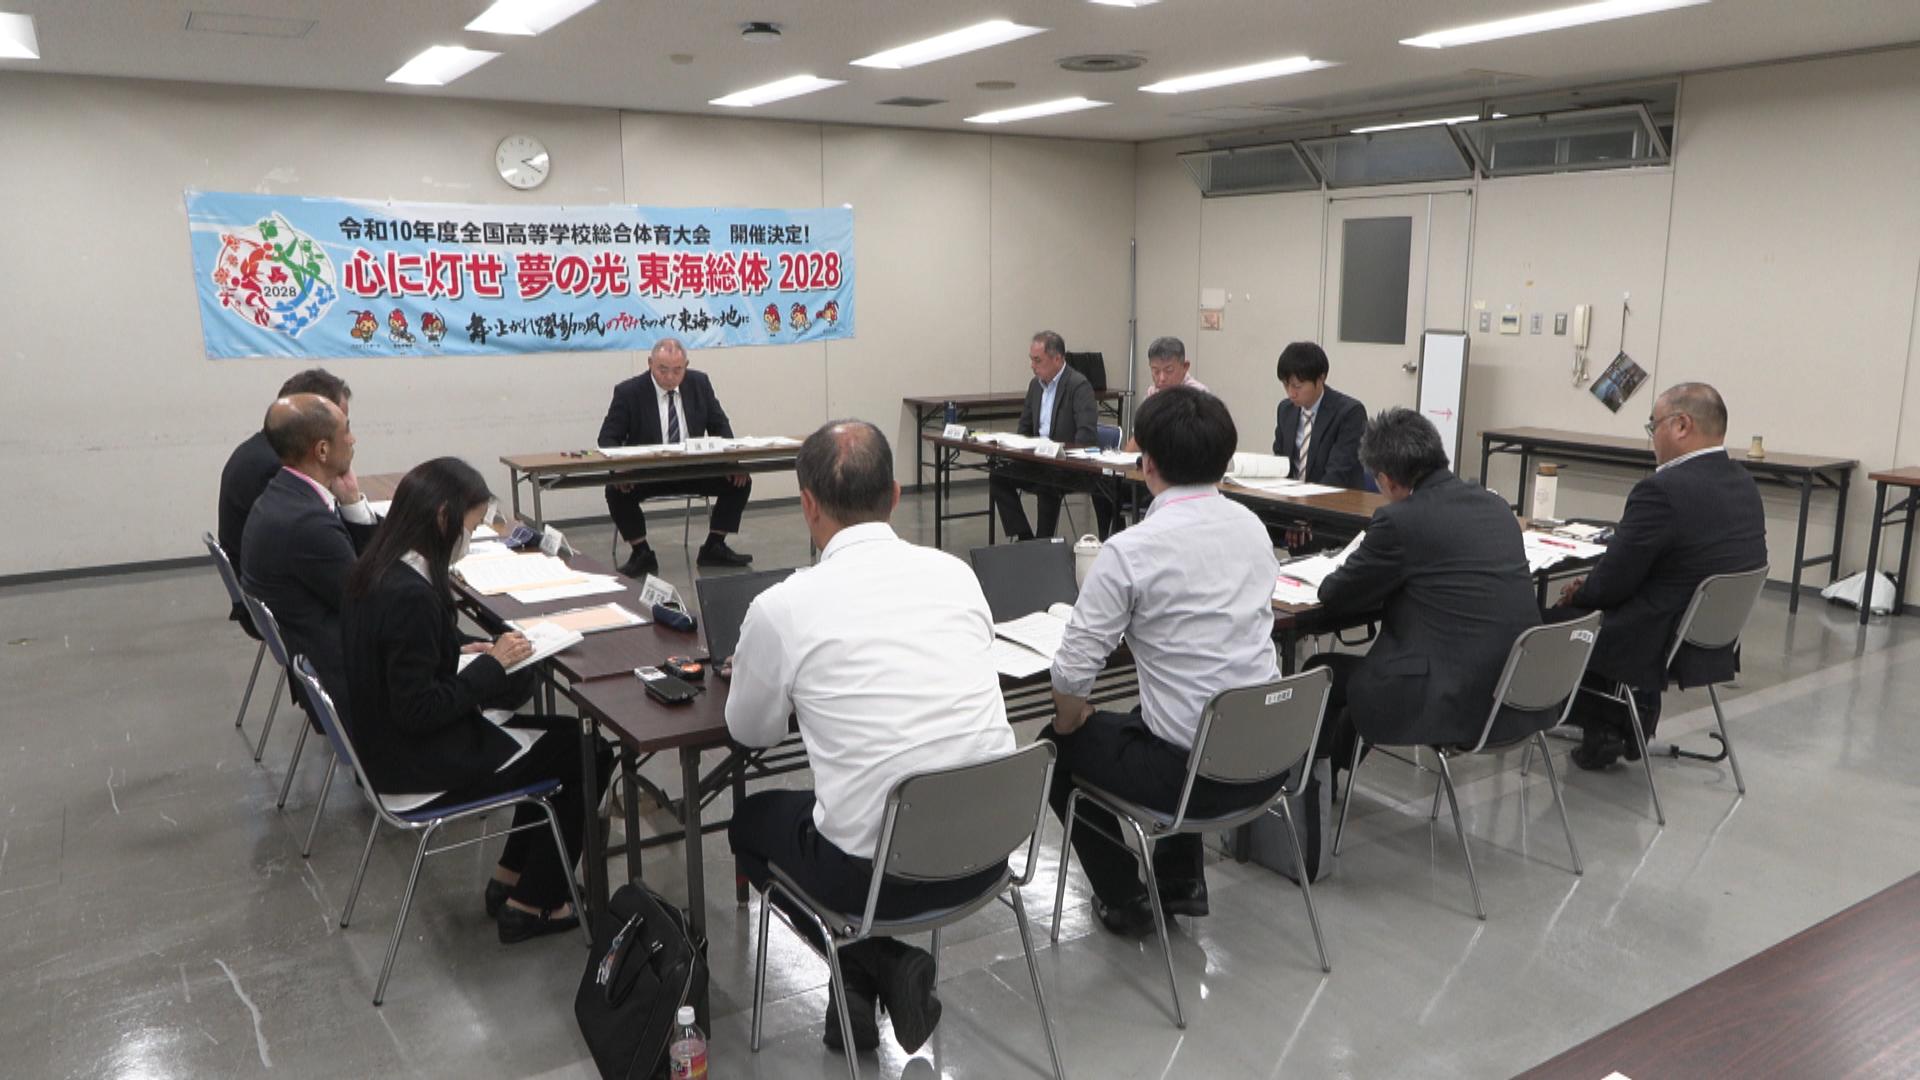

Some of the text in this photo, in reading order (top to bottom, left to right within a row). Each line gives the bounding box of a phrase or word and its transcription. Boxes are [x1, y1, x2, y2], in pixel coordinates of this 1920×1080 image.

[339, 216, 711, 245] 令和10年度全国高等学校総合体育大会
[344, 248, 840, 299] 心に灯せ 夢の光 東海総体 2028
[263, 286, 297, 297] 2028
